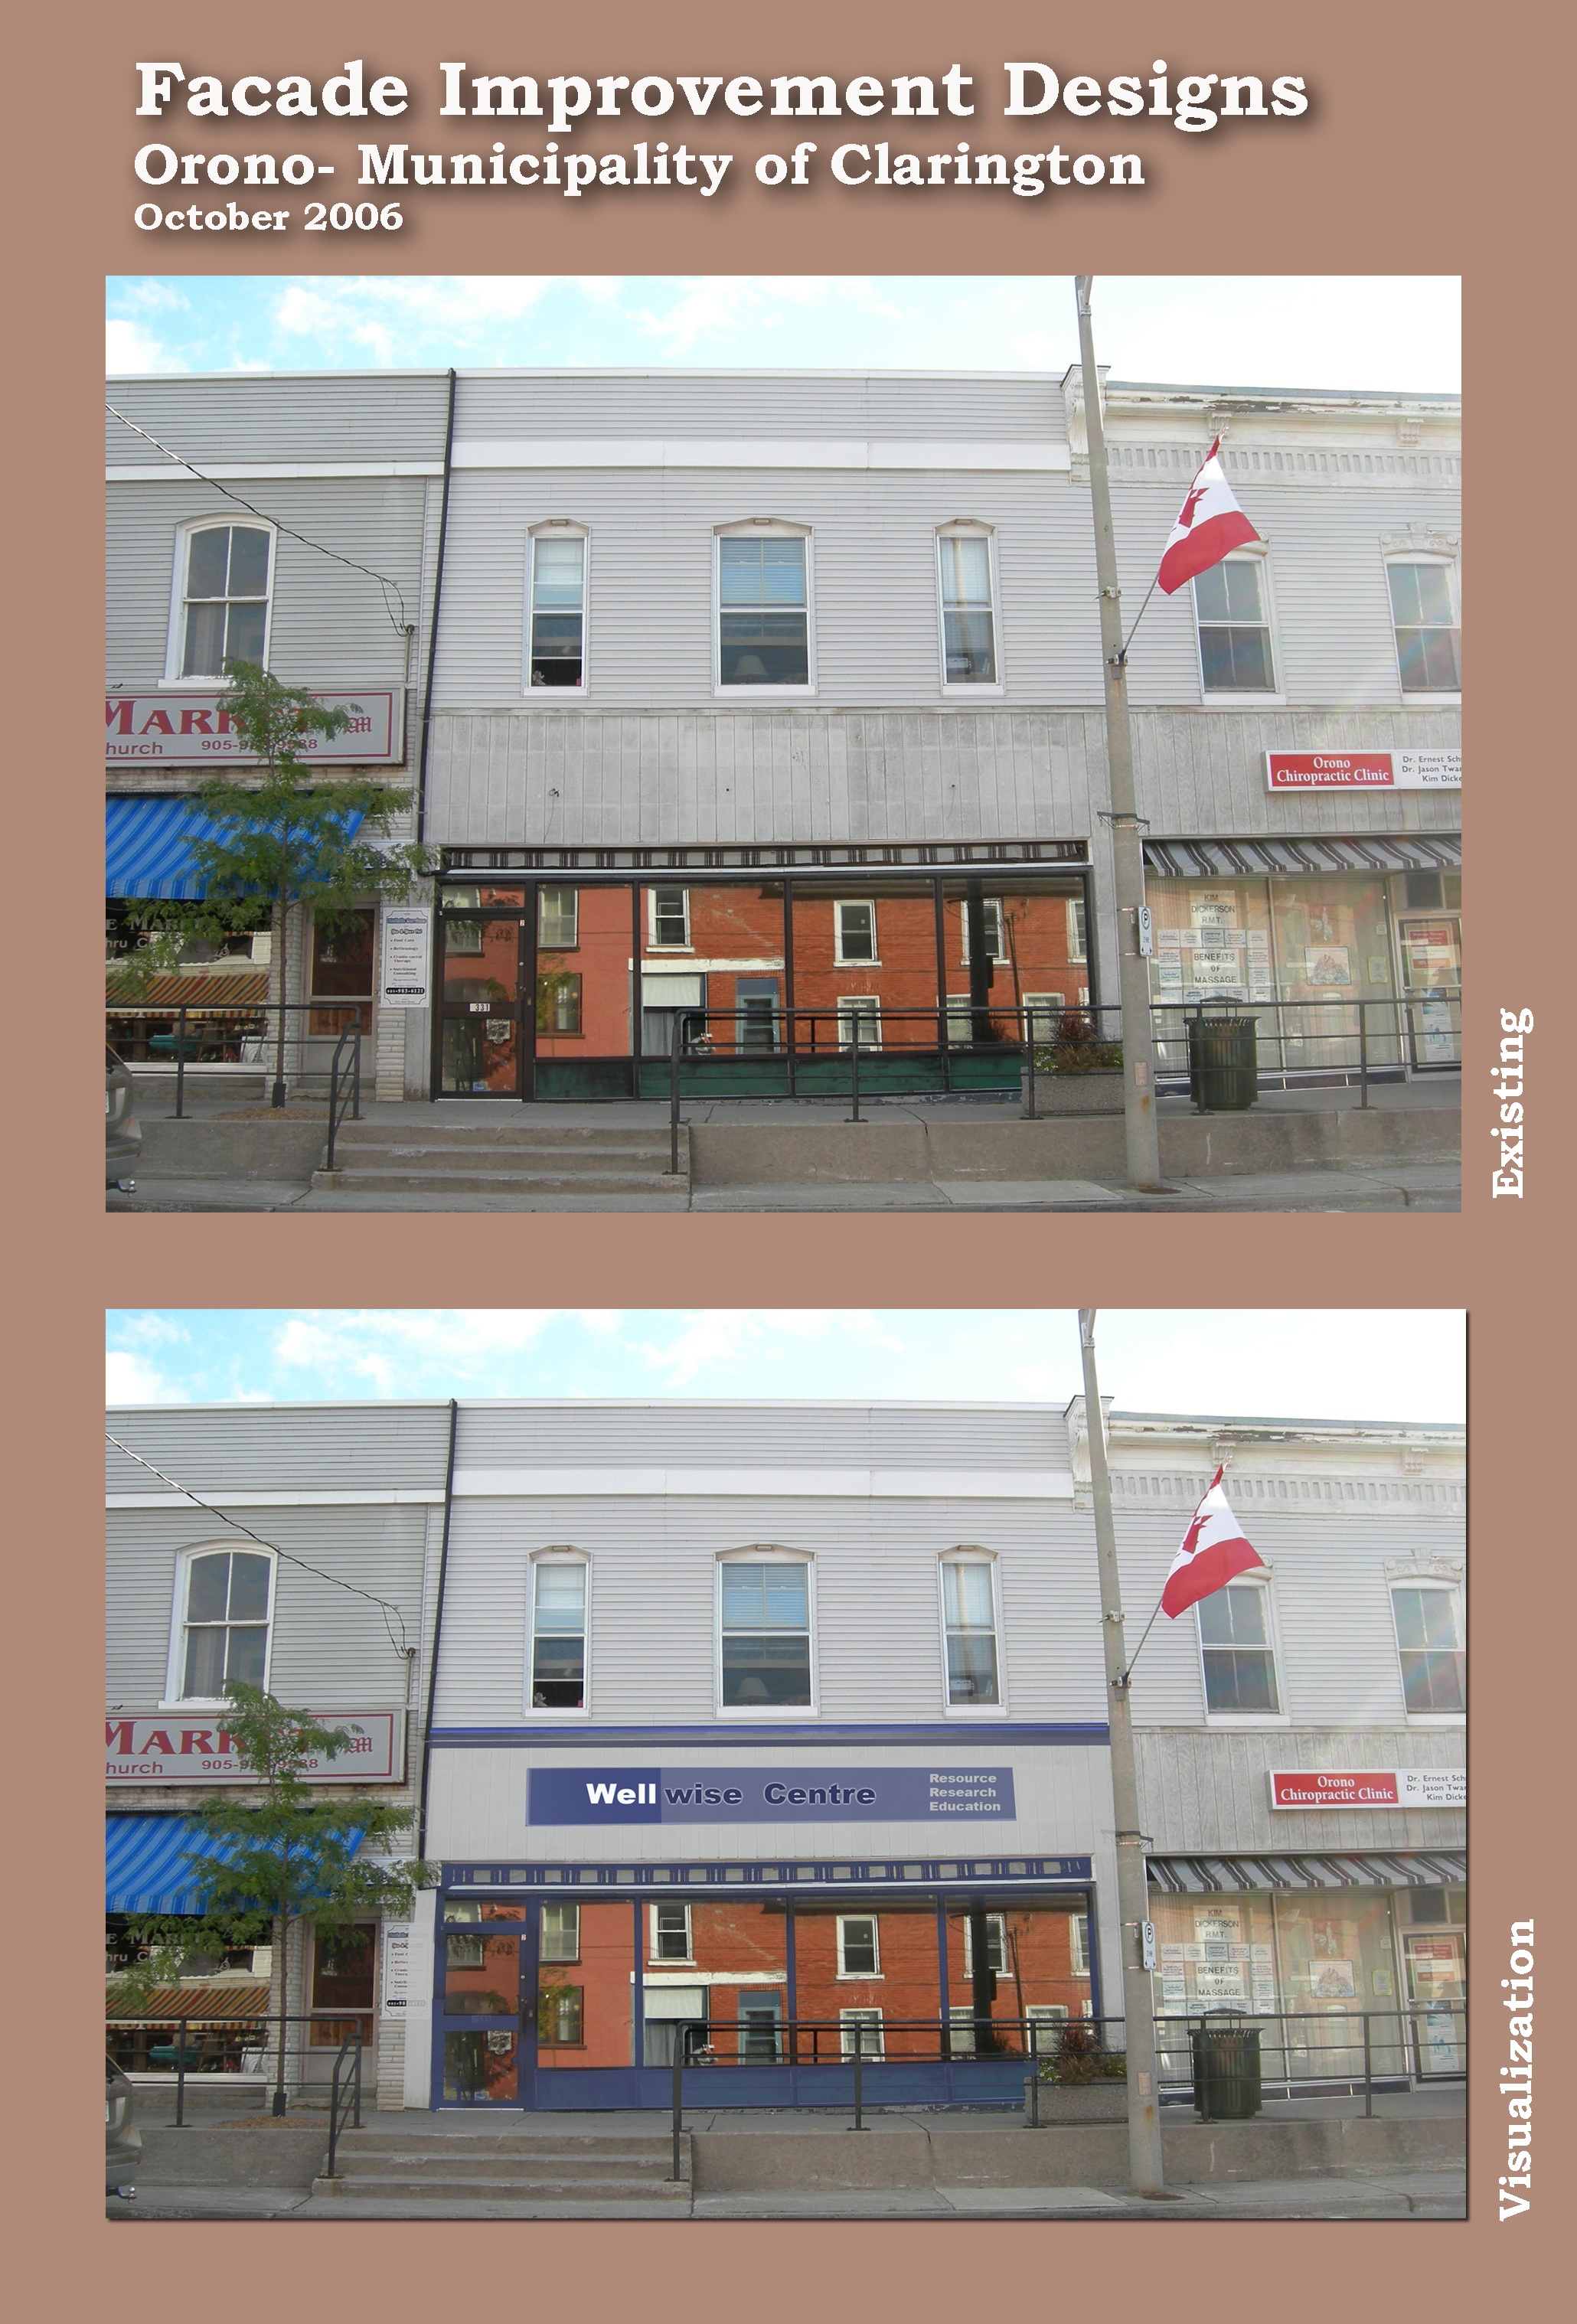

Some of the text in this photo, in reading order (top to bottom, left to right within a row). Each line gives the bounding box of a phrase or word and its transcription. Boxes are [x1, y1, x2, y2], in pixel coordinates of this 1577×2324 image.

[1313, 756, 1350, 769] Orono
[1418, 765, 1439, 775] Jason
[1276, 769, 1389, 785] Chiropractic Clinic
[929, 1774, 997, 1783] Resource
[1317, 1775, 1354, 1787] Orono
[586, 1782, 876, 1805] Well wise Centre
[929, 1787, 996, 1797] Research
[1422, 1784, 1444, 1794] Jason
[1280, 1787, 1394, 1803] Chiropractic Clinic
[929, 1801, 1001, 1811] Education
